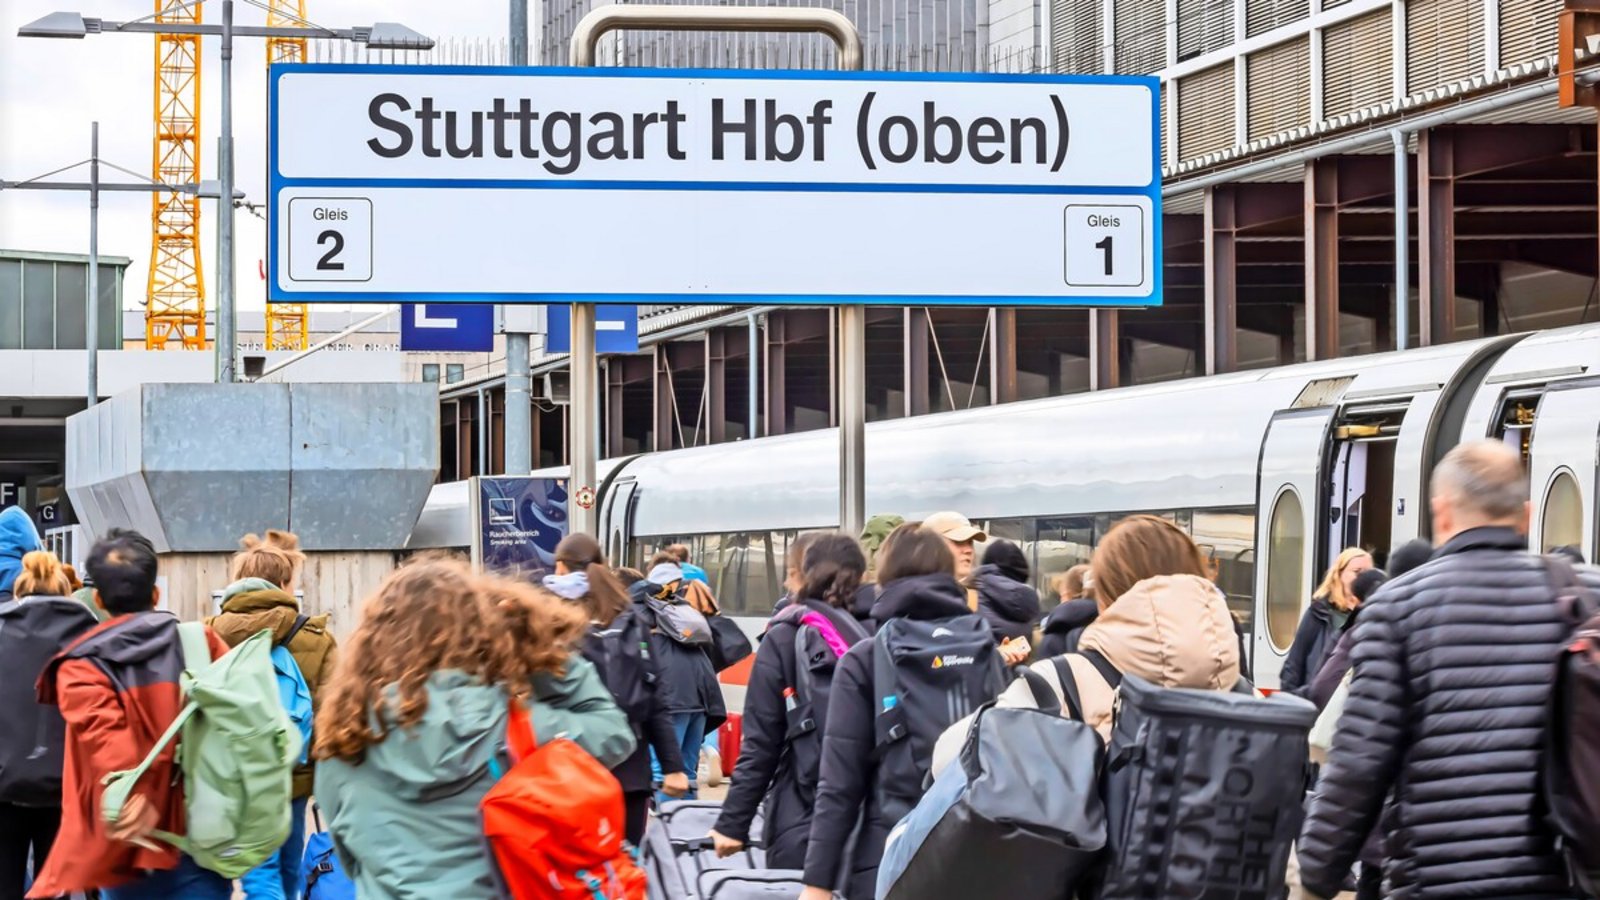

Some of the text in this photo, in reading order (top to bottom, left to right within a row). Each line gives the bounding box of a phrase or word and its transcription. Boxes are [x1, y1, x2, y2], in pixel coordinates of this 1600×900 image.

[367, 92, 1069, 175] Stuttgart Hbf (oben)
[313, 208, 347, 220] Gleis
[1088, 215, 1120, 227] Gleis
[317, 230, 344, 270] 2
[1096, 236, 1112, 275] 1
[0, 482, 15, 505] F
[43, 505, 55, 520] G
[1241, 806, 1278, 887] THE
